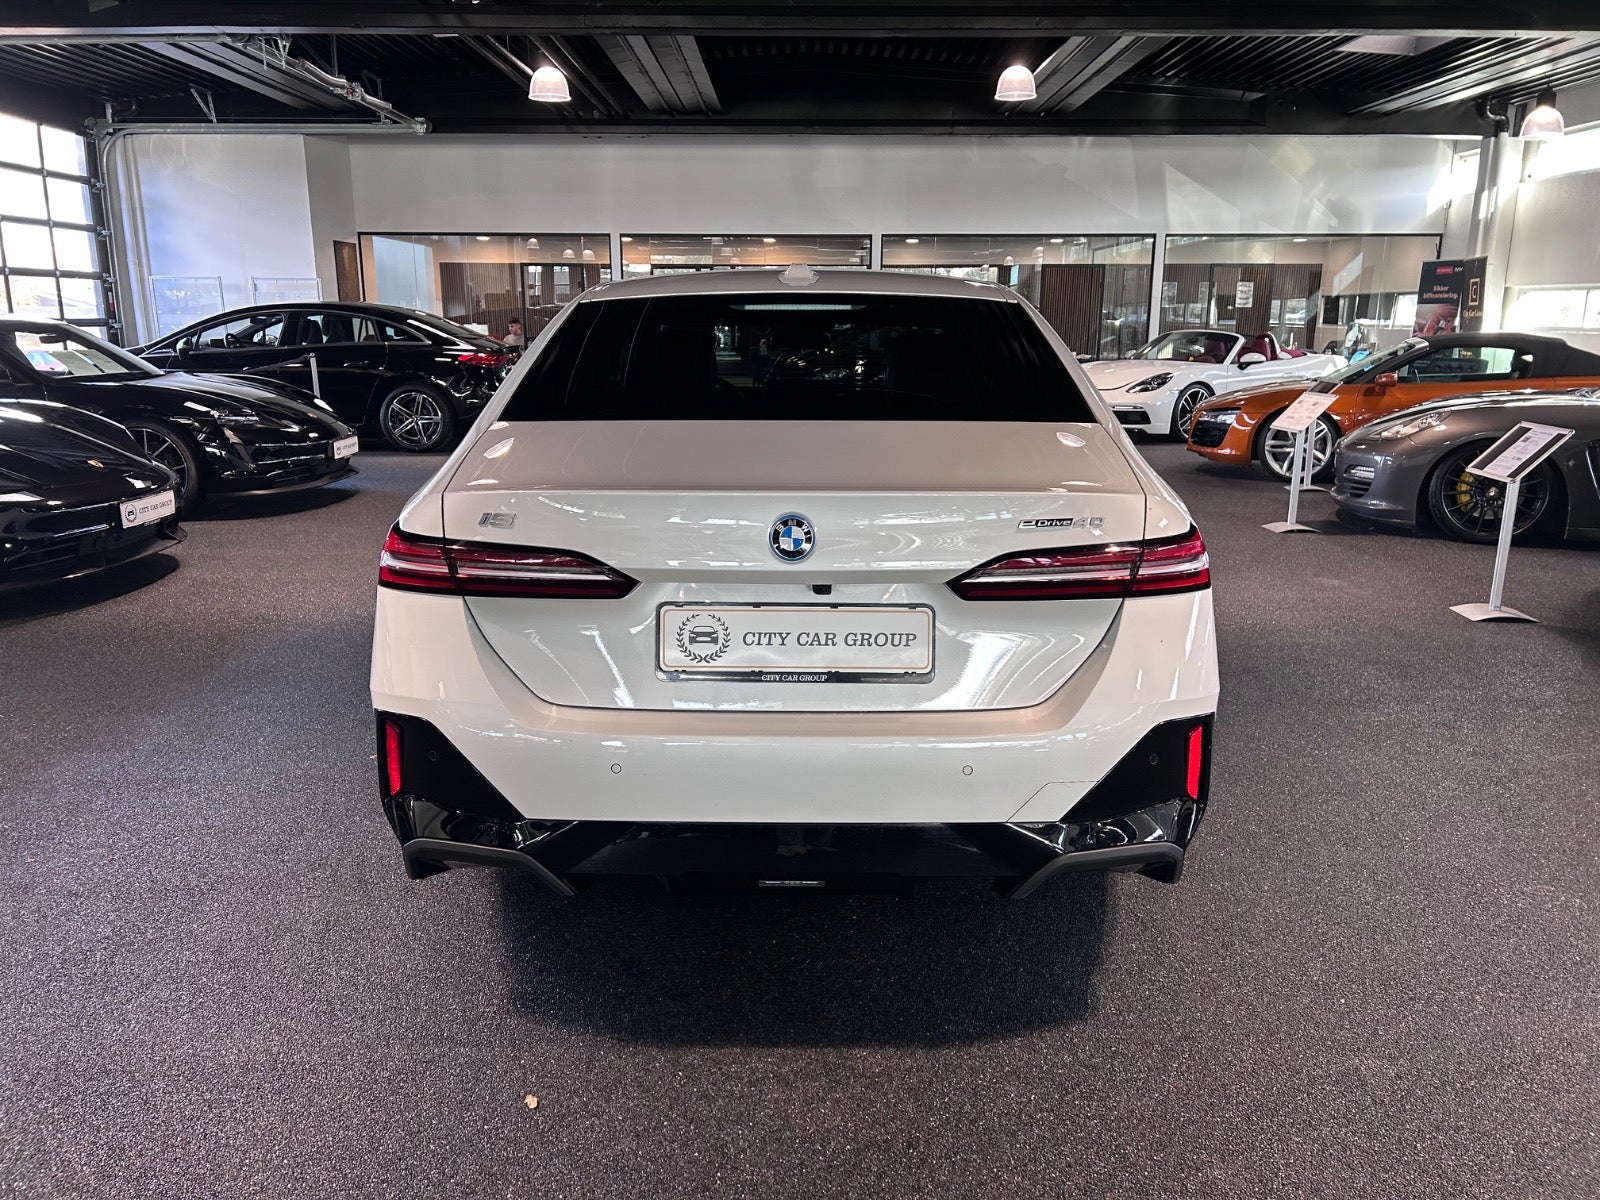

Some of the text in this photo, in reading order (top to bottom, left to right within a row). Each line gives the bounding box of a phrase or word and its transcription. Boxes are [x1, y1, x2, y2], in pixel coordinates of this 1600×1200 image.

[775, 519, 810, 532] BMW
[742, 631, 918, 648] CITY CAR GROUP
[761, 674, 828, 682] CITY CAR GROUP
